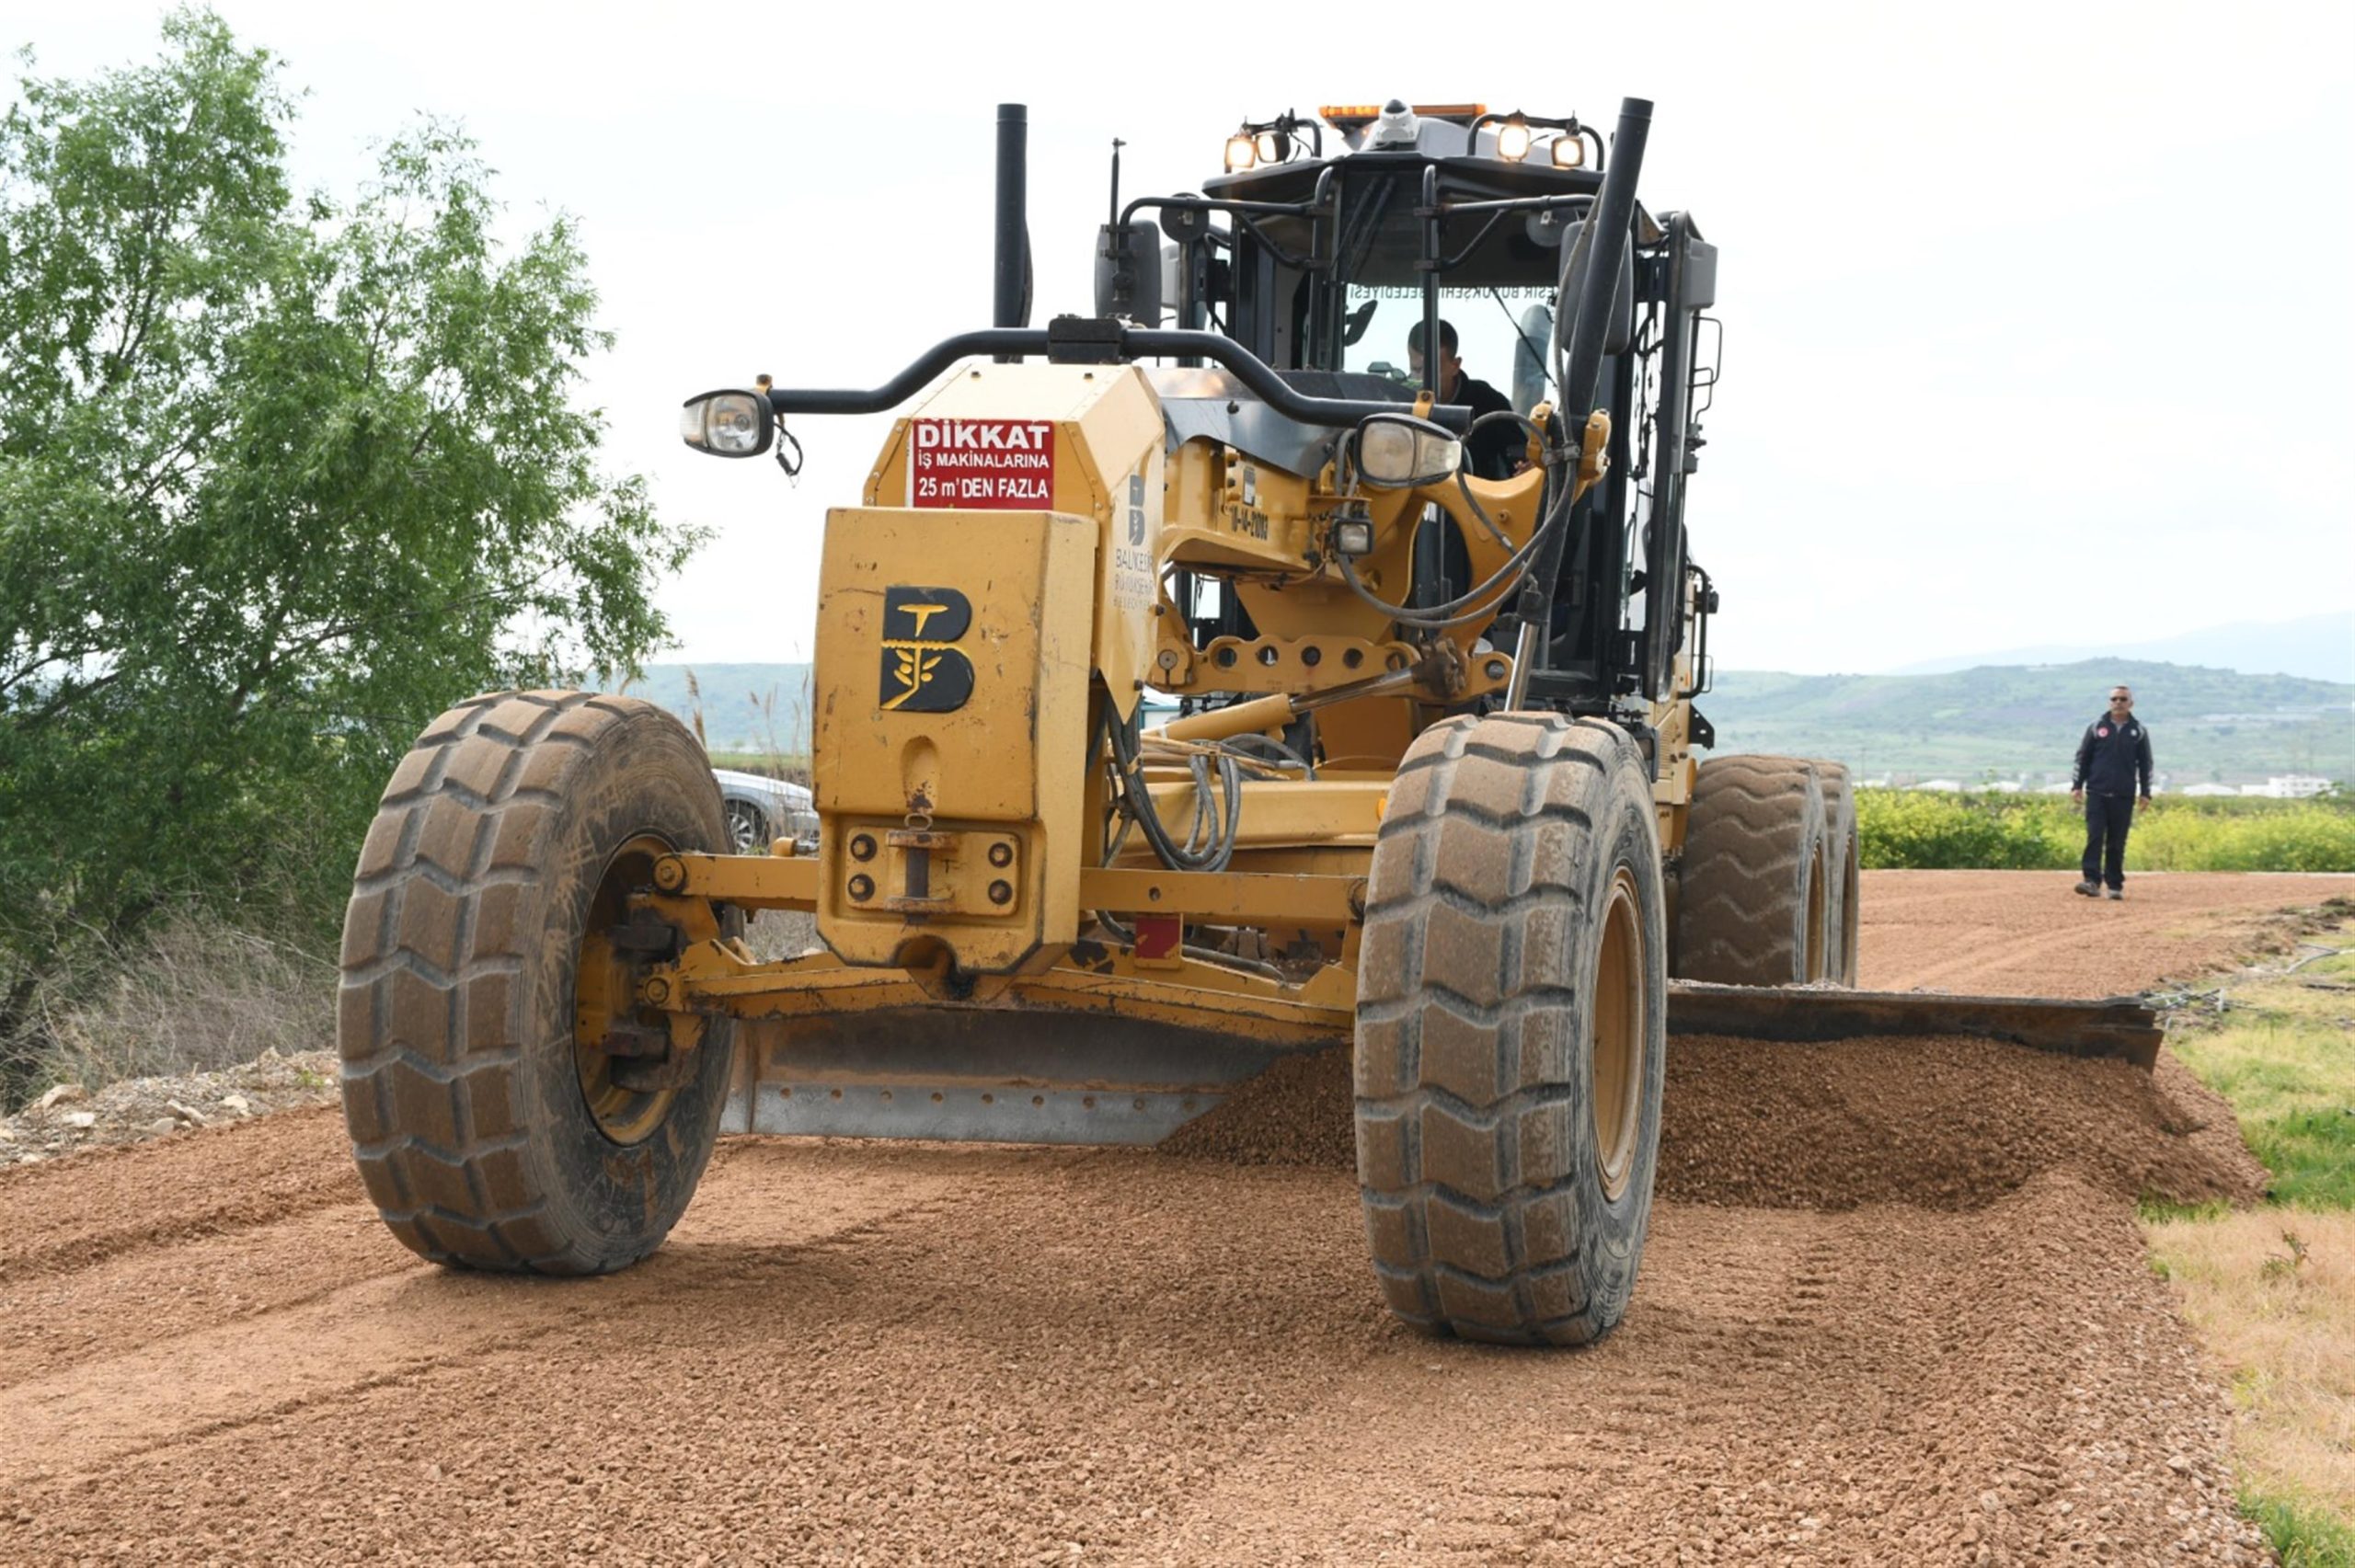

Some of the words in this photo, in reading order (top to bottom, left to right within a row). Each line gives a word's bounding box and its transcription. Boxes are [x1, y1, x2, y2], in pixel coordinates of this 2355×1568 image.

[918, 421, 1050, 450] DİKKAT
[918, 449, 932, 469] İŞ
[936, 450, 1050, 469] MAKİNALARINA
[919, 477, 937, 497] 25
[998, 478, 1049, 498] FAZLA
